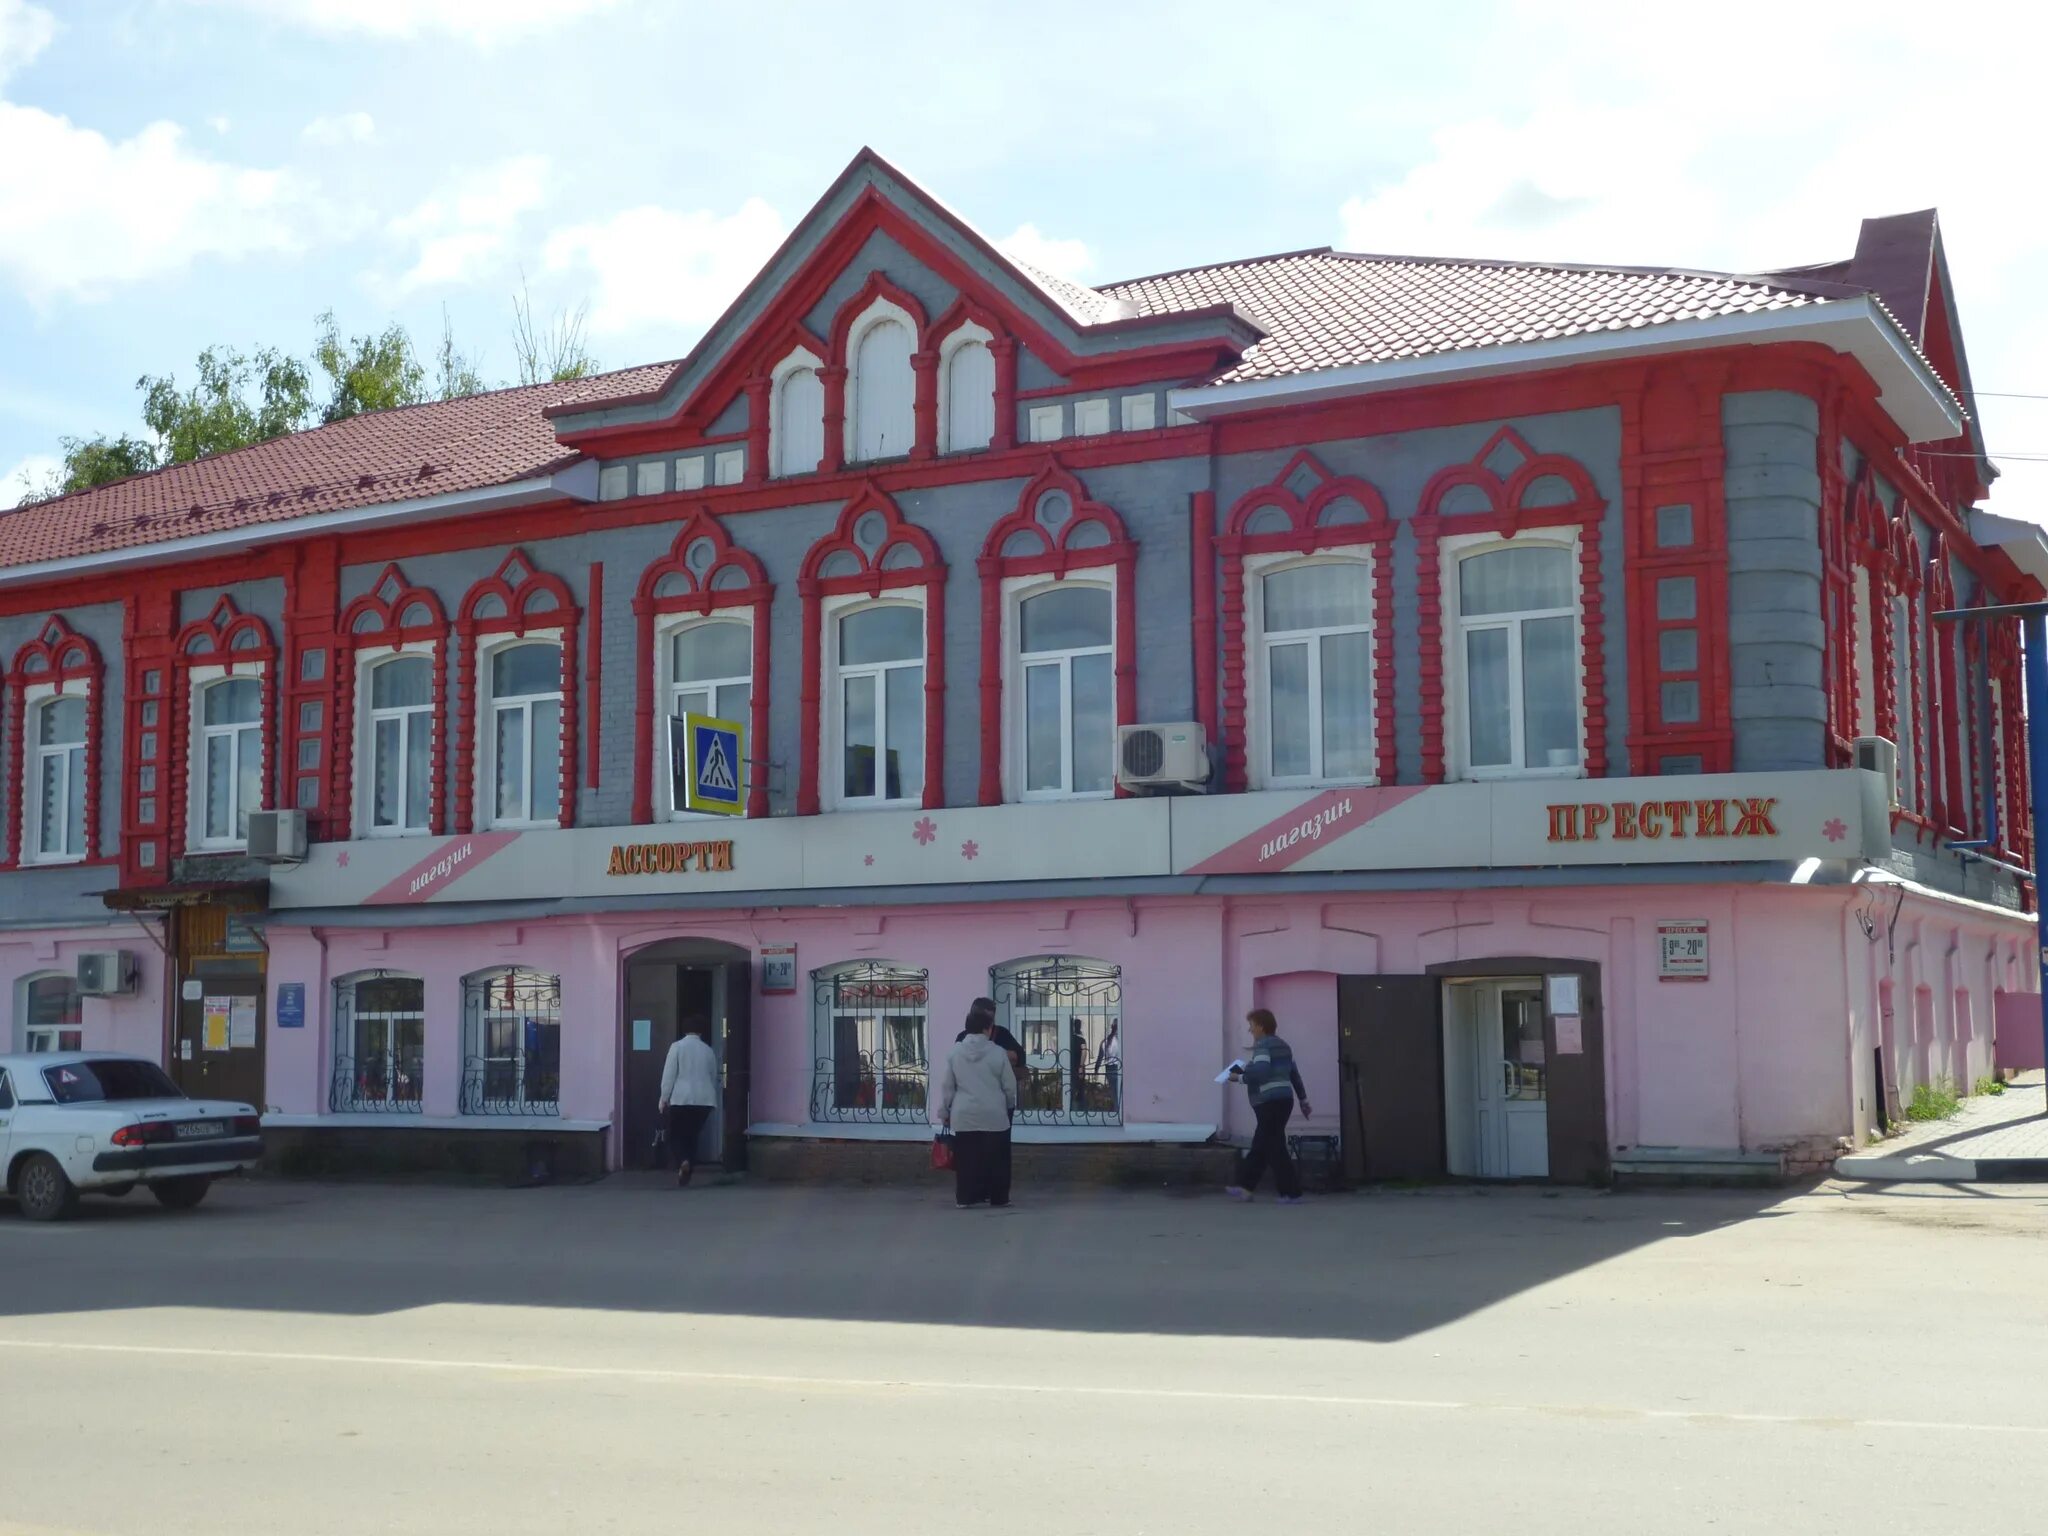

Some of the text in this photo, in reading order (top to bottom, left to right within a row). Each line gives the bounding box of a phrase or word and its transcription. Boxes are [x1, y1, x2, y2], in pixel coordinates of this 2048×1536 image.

[1258, 797, 1353, 862] магазин
[1546, 798, 1778, 842] ПРЕСТИЖ
[408, 841, 473, 896] магазин
[606, 840, 734, 876] АССОРТИ
